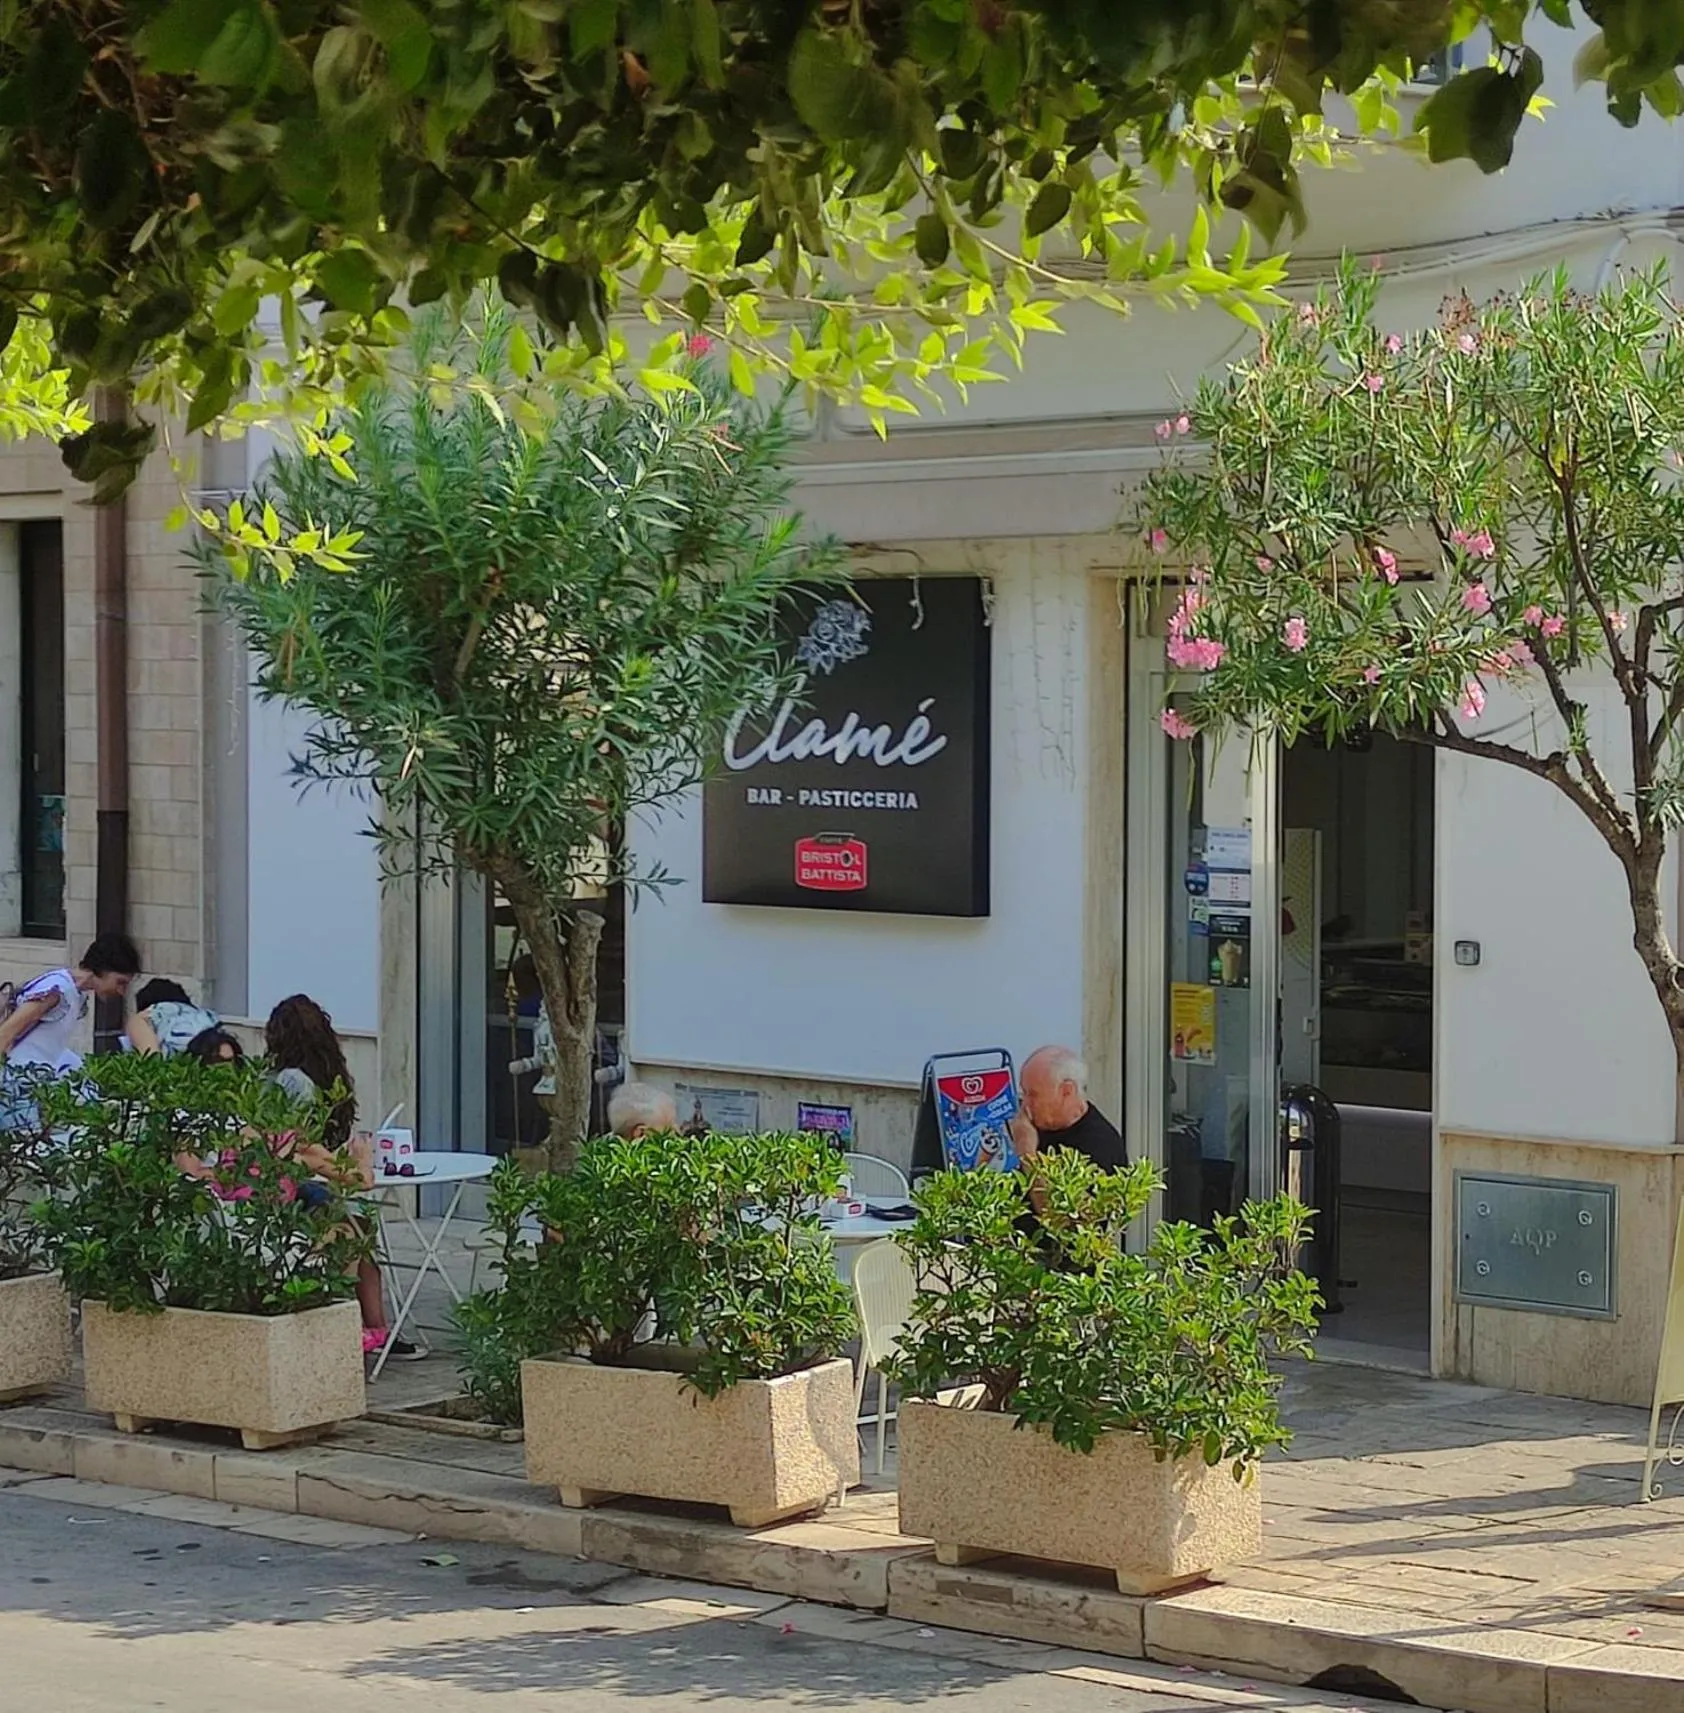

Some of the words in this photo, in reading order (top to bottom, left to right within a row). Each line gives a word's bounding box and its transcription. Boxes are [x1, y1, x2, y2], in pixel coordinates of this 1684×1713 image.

[747, 788, 782, 805] BAR
[799, 789, 919, 809] PASTICCERIA
[801, 868, 863, 882] BATTISTA
[1510, 1228, 1557, 1256] AQP
